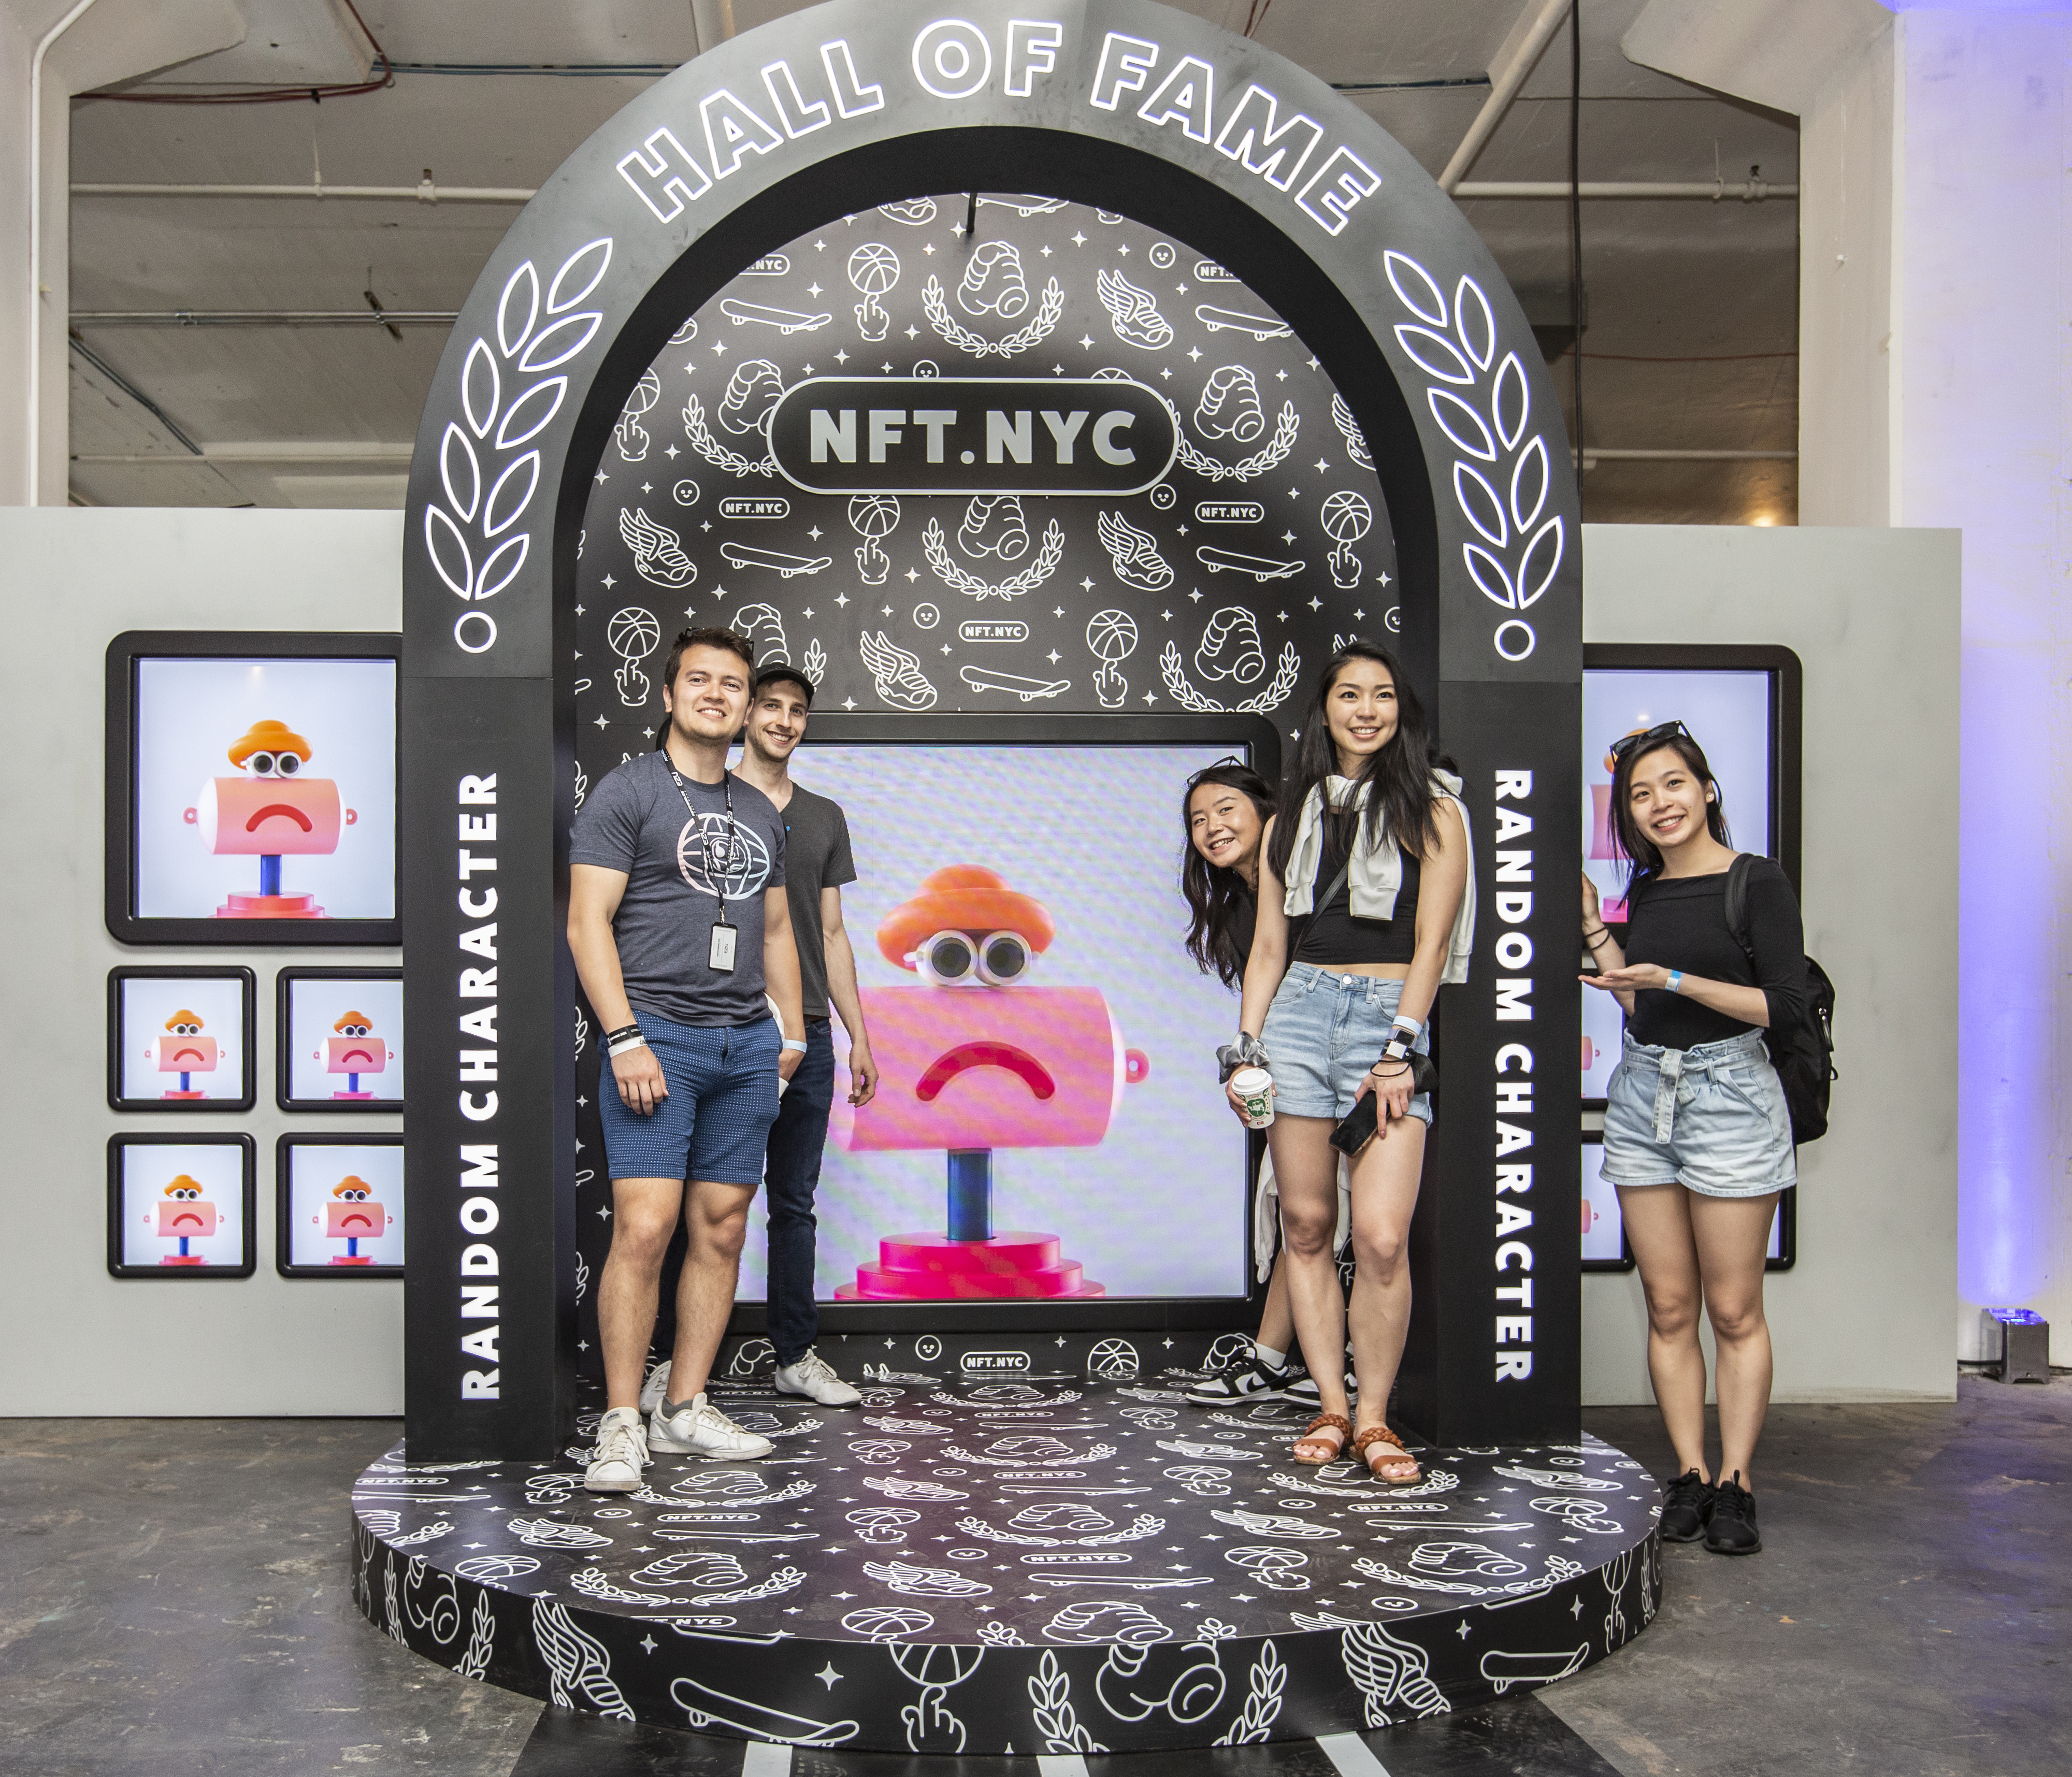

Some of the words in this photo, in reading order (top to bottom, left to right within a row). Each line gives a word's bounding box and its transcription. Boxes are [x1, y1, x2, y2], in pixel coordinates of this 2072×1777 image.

[616, 39, 885, 224] HALL
[912, 19, 1063, 99] OF
[1089, 32, 1382, 237] FAME
[746, 260, 783, 270] .NYC
[1200, 266, 1234, 277] NFT.
[810, 409, 1136, 466] NFT.NYC
[725, 503, 782, 513] NFT.NYC
[1201, 507, 1257, 518] NFT.NYC
[965, 626, 1021, 637] NFT.NYC
[1495, 770, 1533, 1020] RANDOM
[458, 773, 498, 1121] CHARACTER
[1495, 1043, 1533, 1382] CHARACTER
[460, 1144, 500, 1399] RANDOM
[967, 1356, 1023, 1367] NFT.NYC
